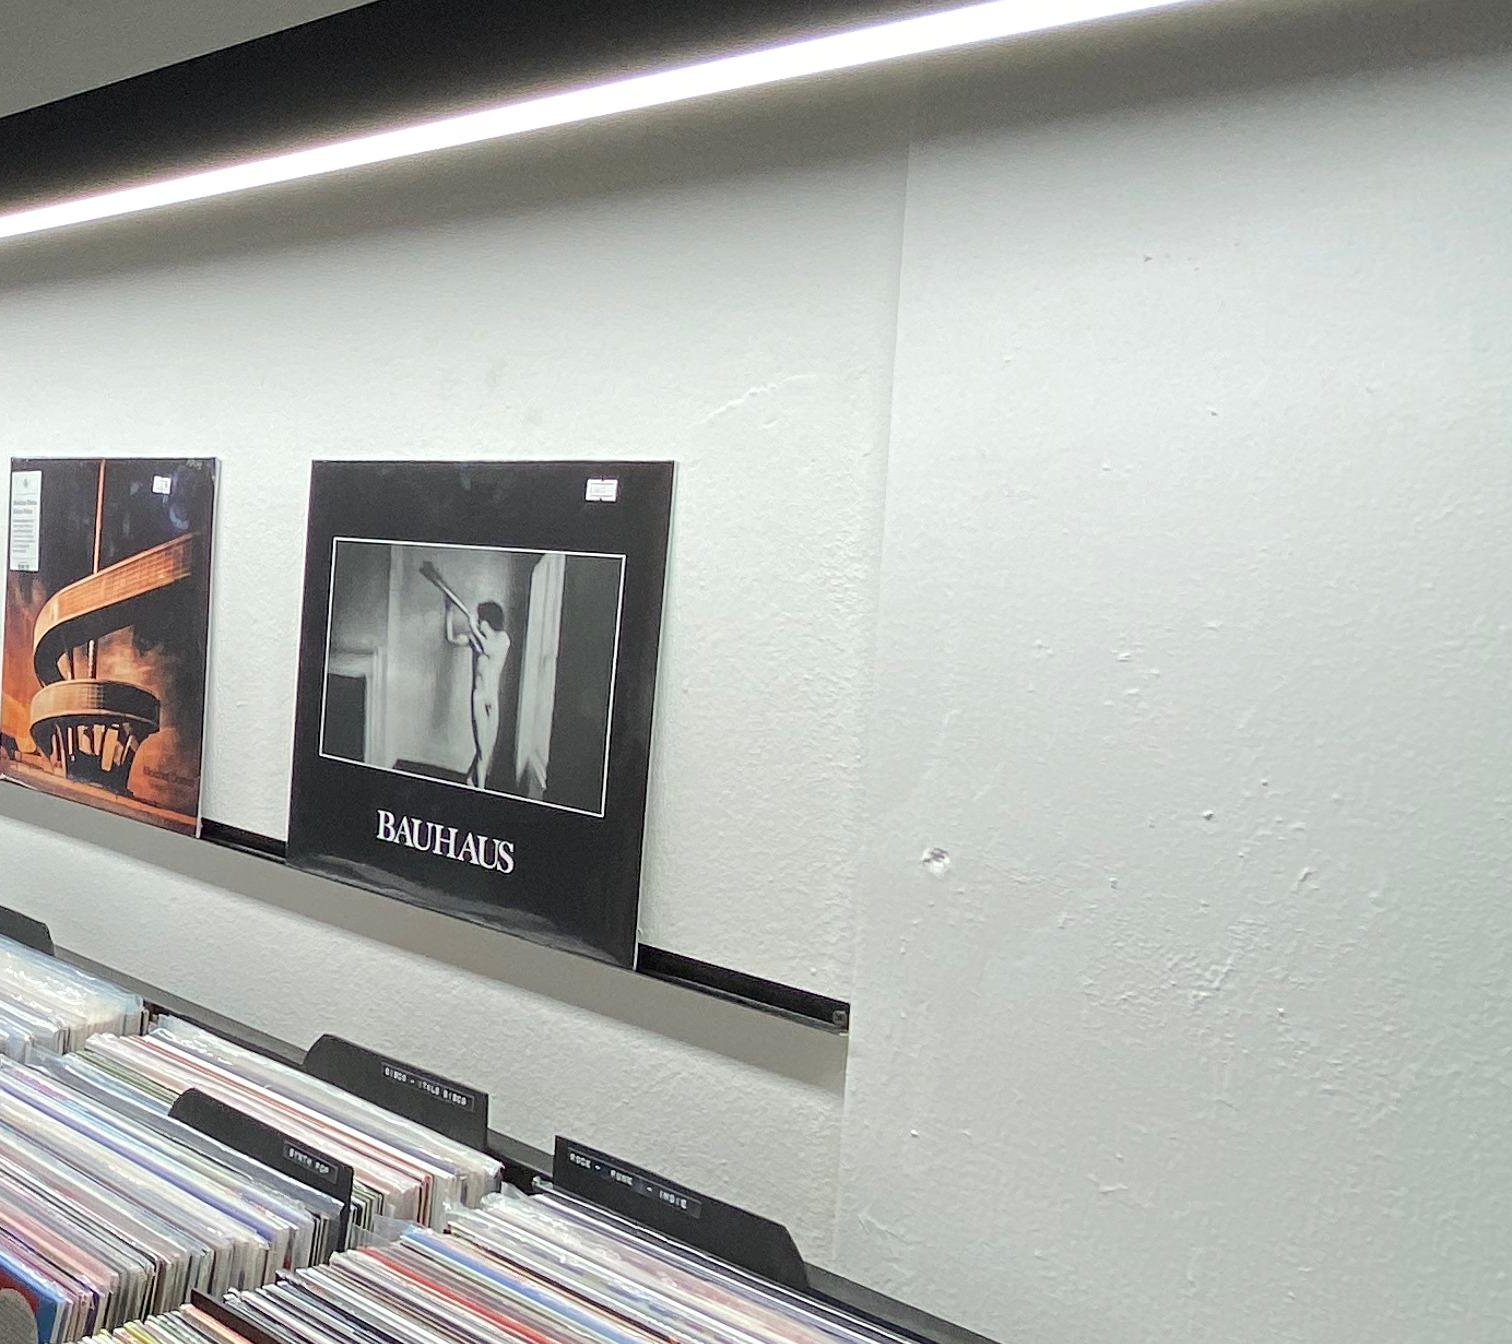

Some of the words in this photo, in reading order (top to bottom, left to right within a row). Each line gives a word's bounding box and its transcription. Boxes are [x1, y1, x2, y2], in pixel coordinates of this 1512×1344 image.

[376, 809, 515, 874] BAUHAUS
[569, 1153, 591, 1169] ROCK
[659, 1190, 687, 1210] INDIE
